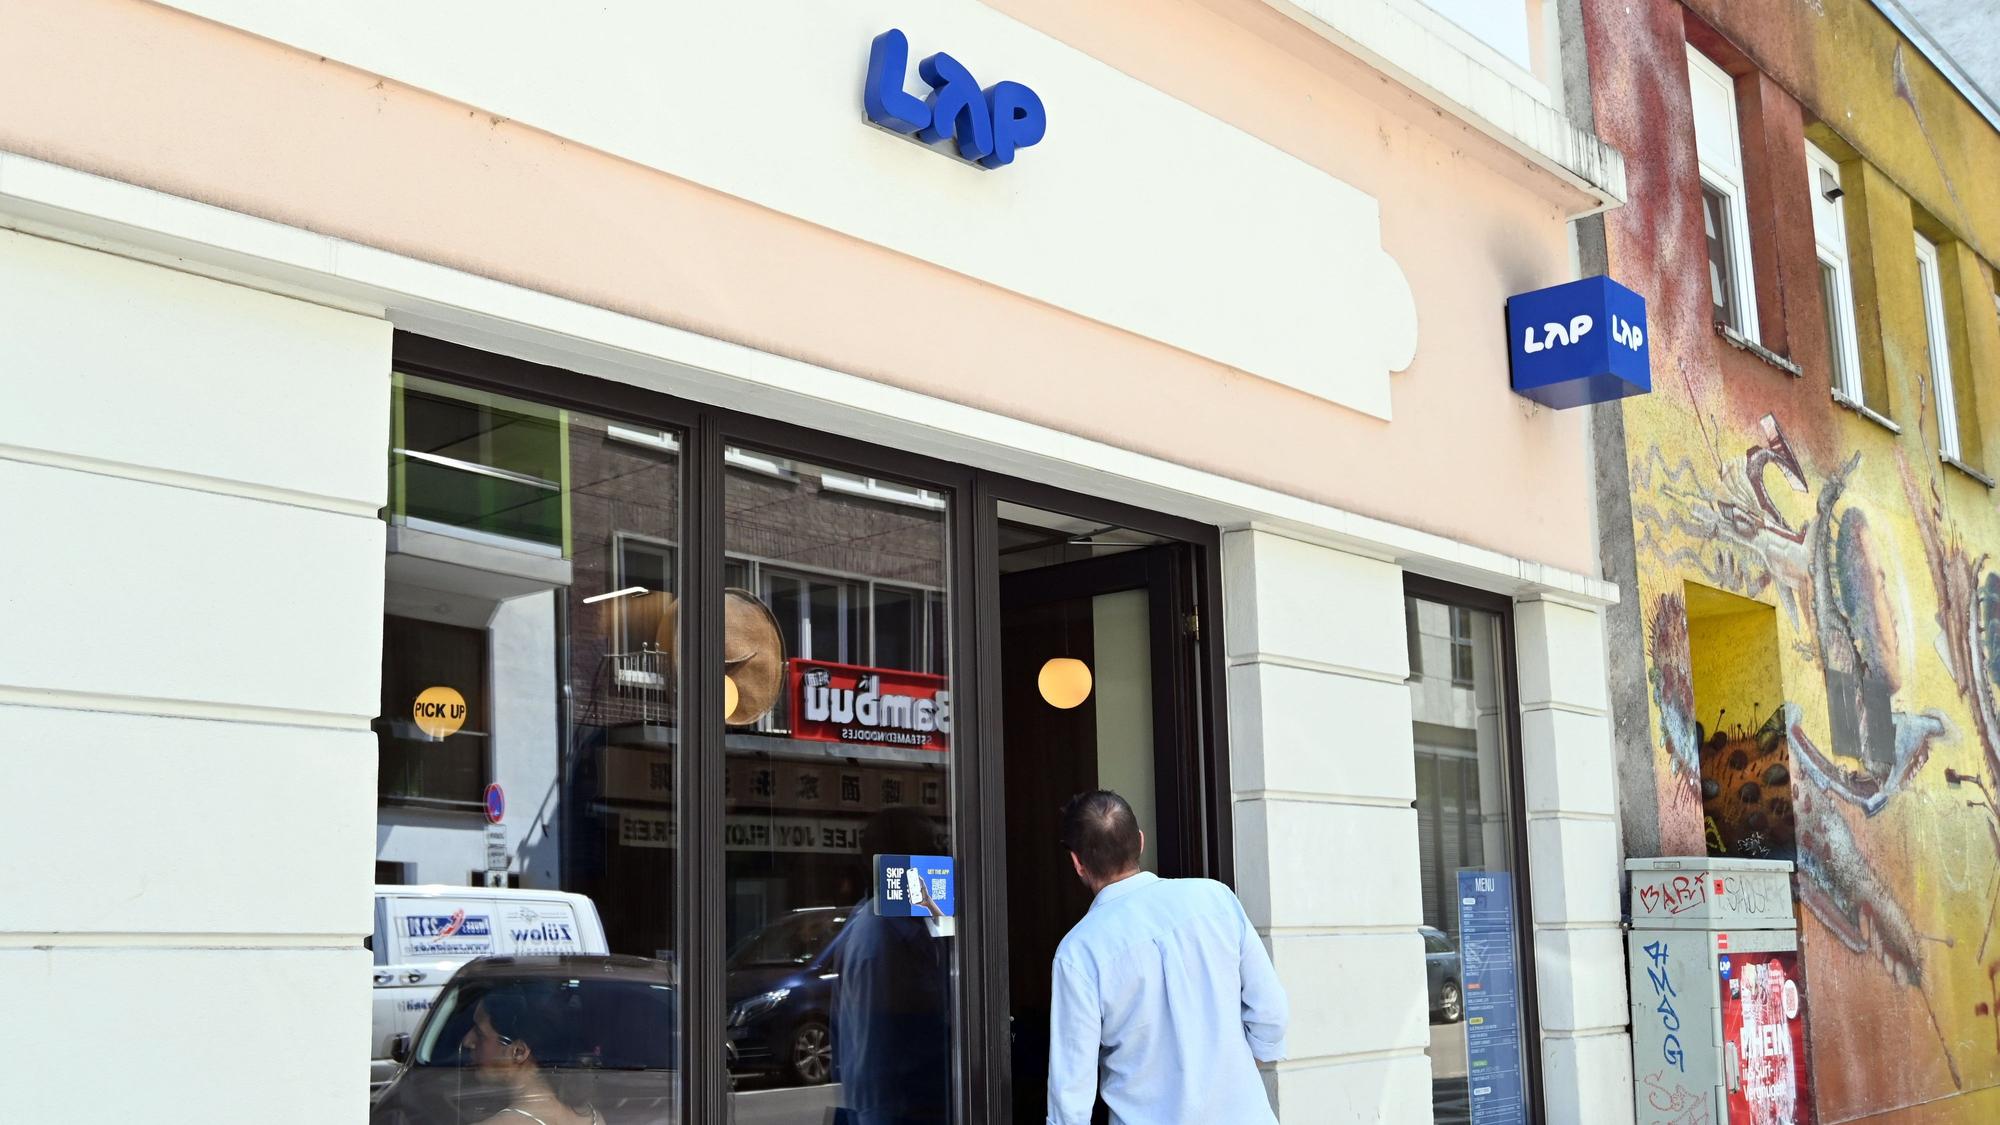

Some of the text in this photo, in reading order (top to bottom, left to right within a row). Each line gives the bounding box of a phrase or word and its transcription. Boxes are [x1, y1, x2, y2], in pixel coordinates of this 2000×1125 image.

[1524, 314, 1593, 353] LAP
[1612, 314, 1643, 351] LAP
[415, 703, 465, 719] PICK UP
[886, 867, 904, 878] SKIP
[886, 879, 901, 889] THE
[1475, 877, 1495, 892] MENU
[886, 890, 903, 900] LINE
